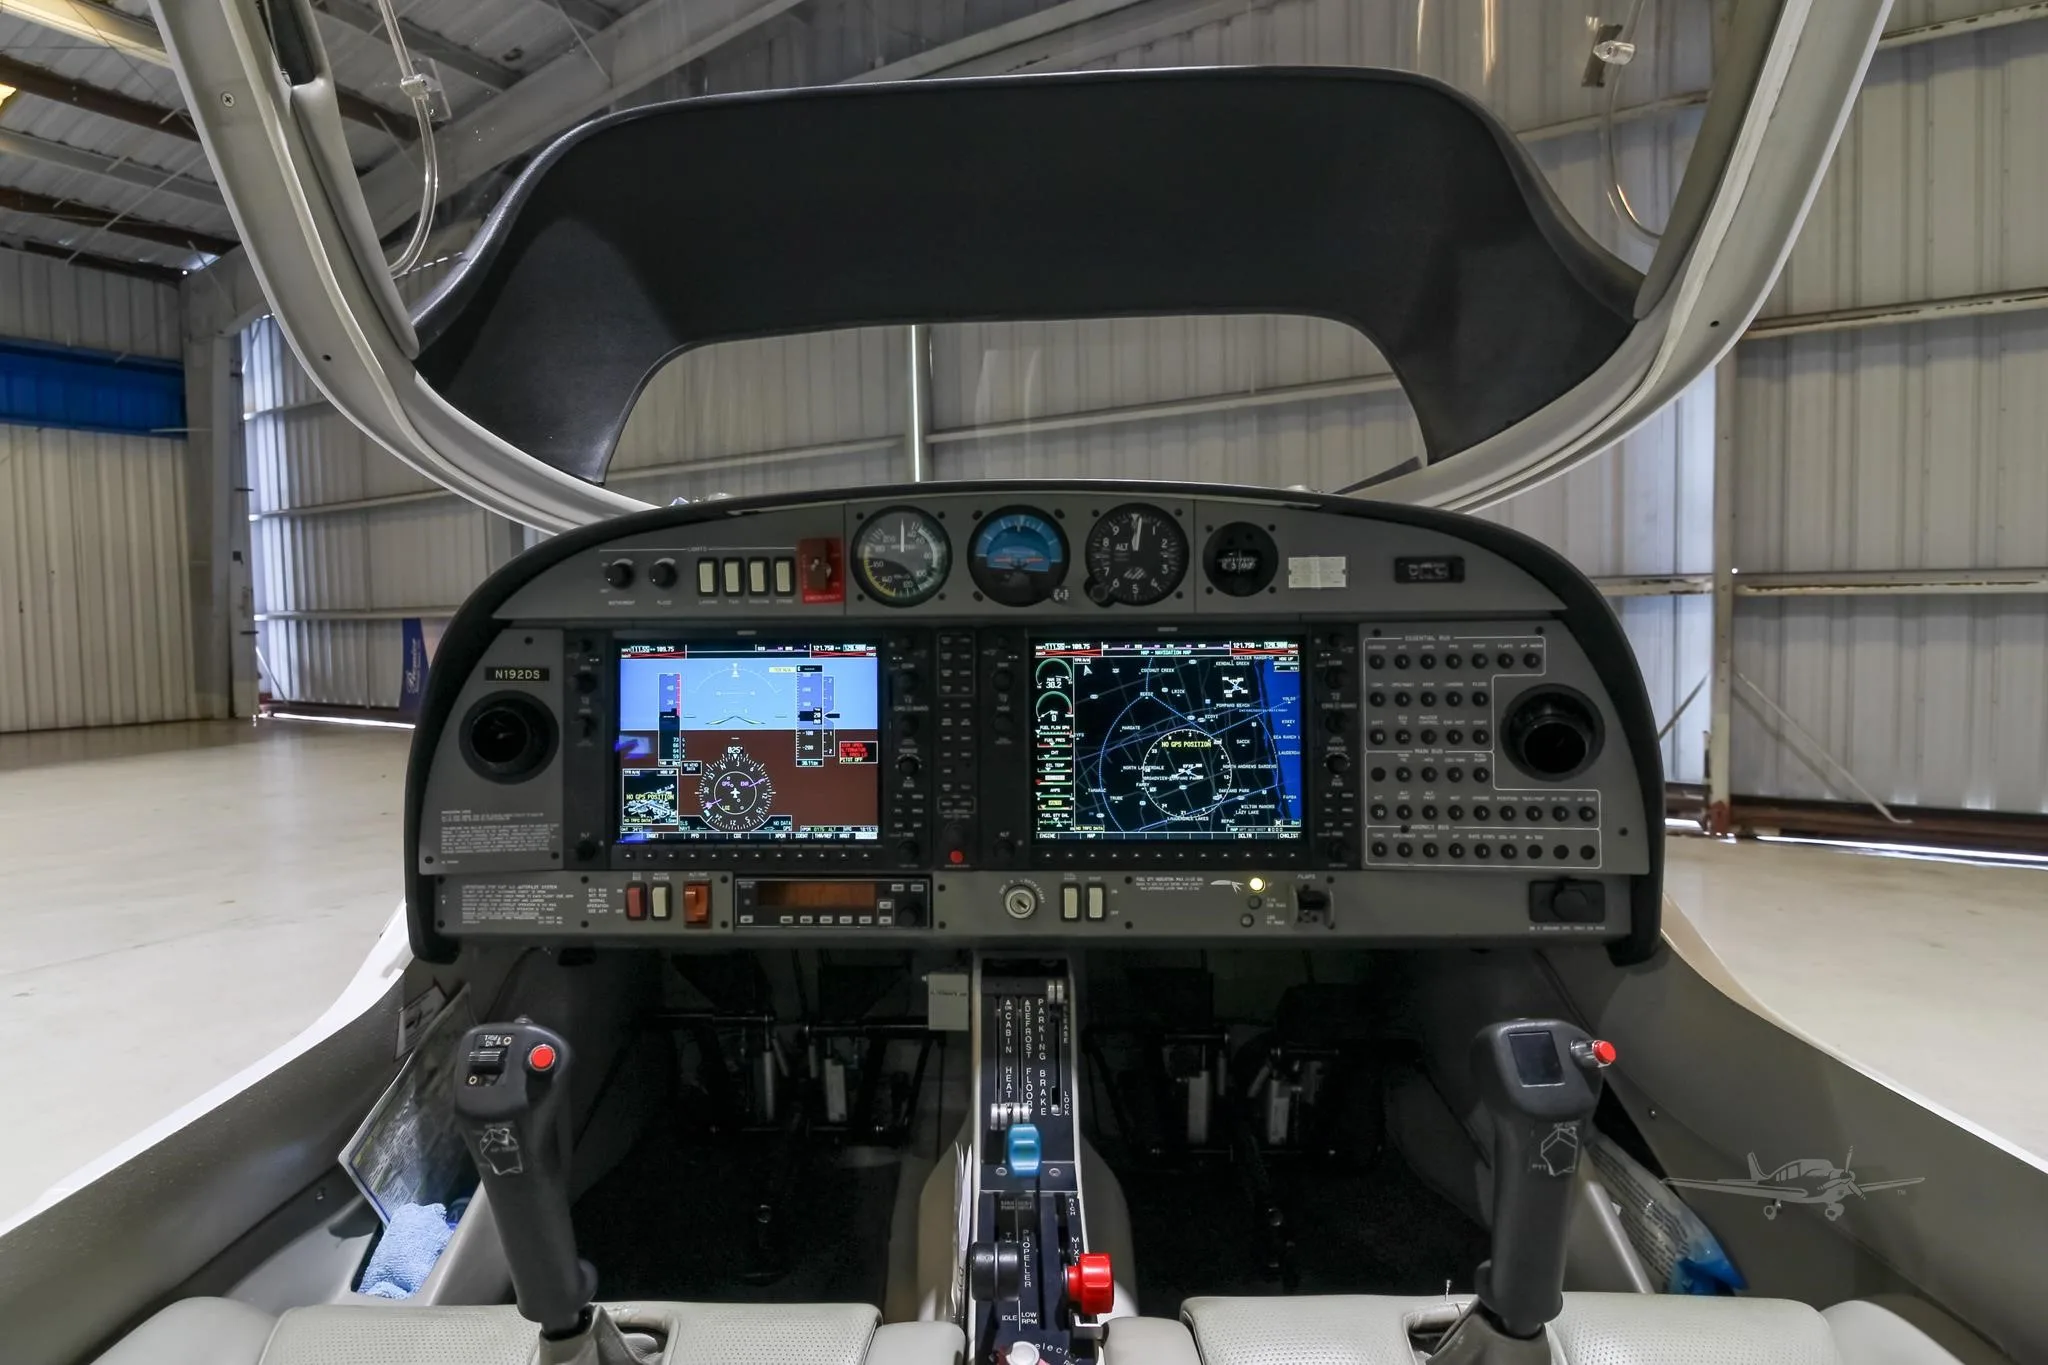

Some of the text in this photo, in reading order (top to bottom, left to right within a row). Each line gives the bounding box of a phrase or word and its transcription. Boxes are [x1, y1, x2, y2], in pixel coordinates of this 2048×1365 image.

[1112, 526, 1120, 536] 9
[1102, 538, 1110, 547] 8
[1161, 538, 1168, 548] 2
[1104, 567, 1110, 576] 7
[1162, 565, 1168, 574] 3
[1112, 578, 1120, 588] 6
[1132, 585, 1138, 594] 5
[494, 669, 541, 680] N192DS
[1038, 998, 1046, 1060] PARKING
[1072, 1236, 1080, 1266] MIXT
